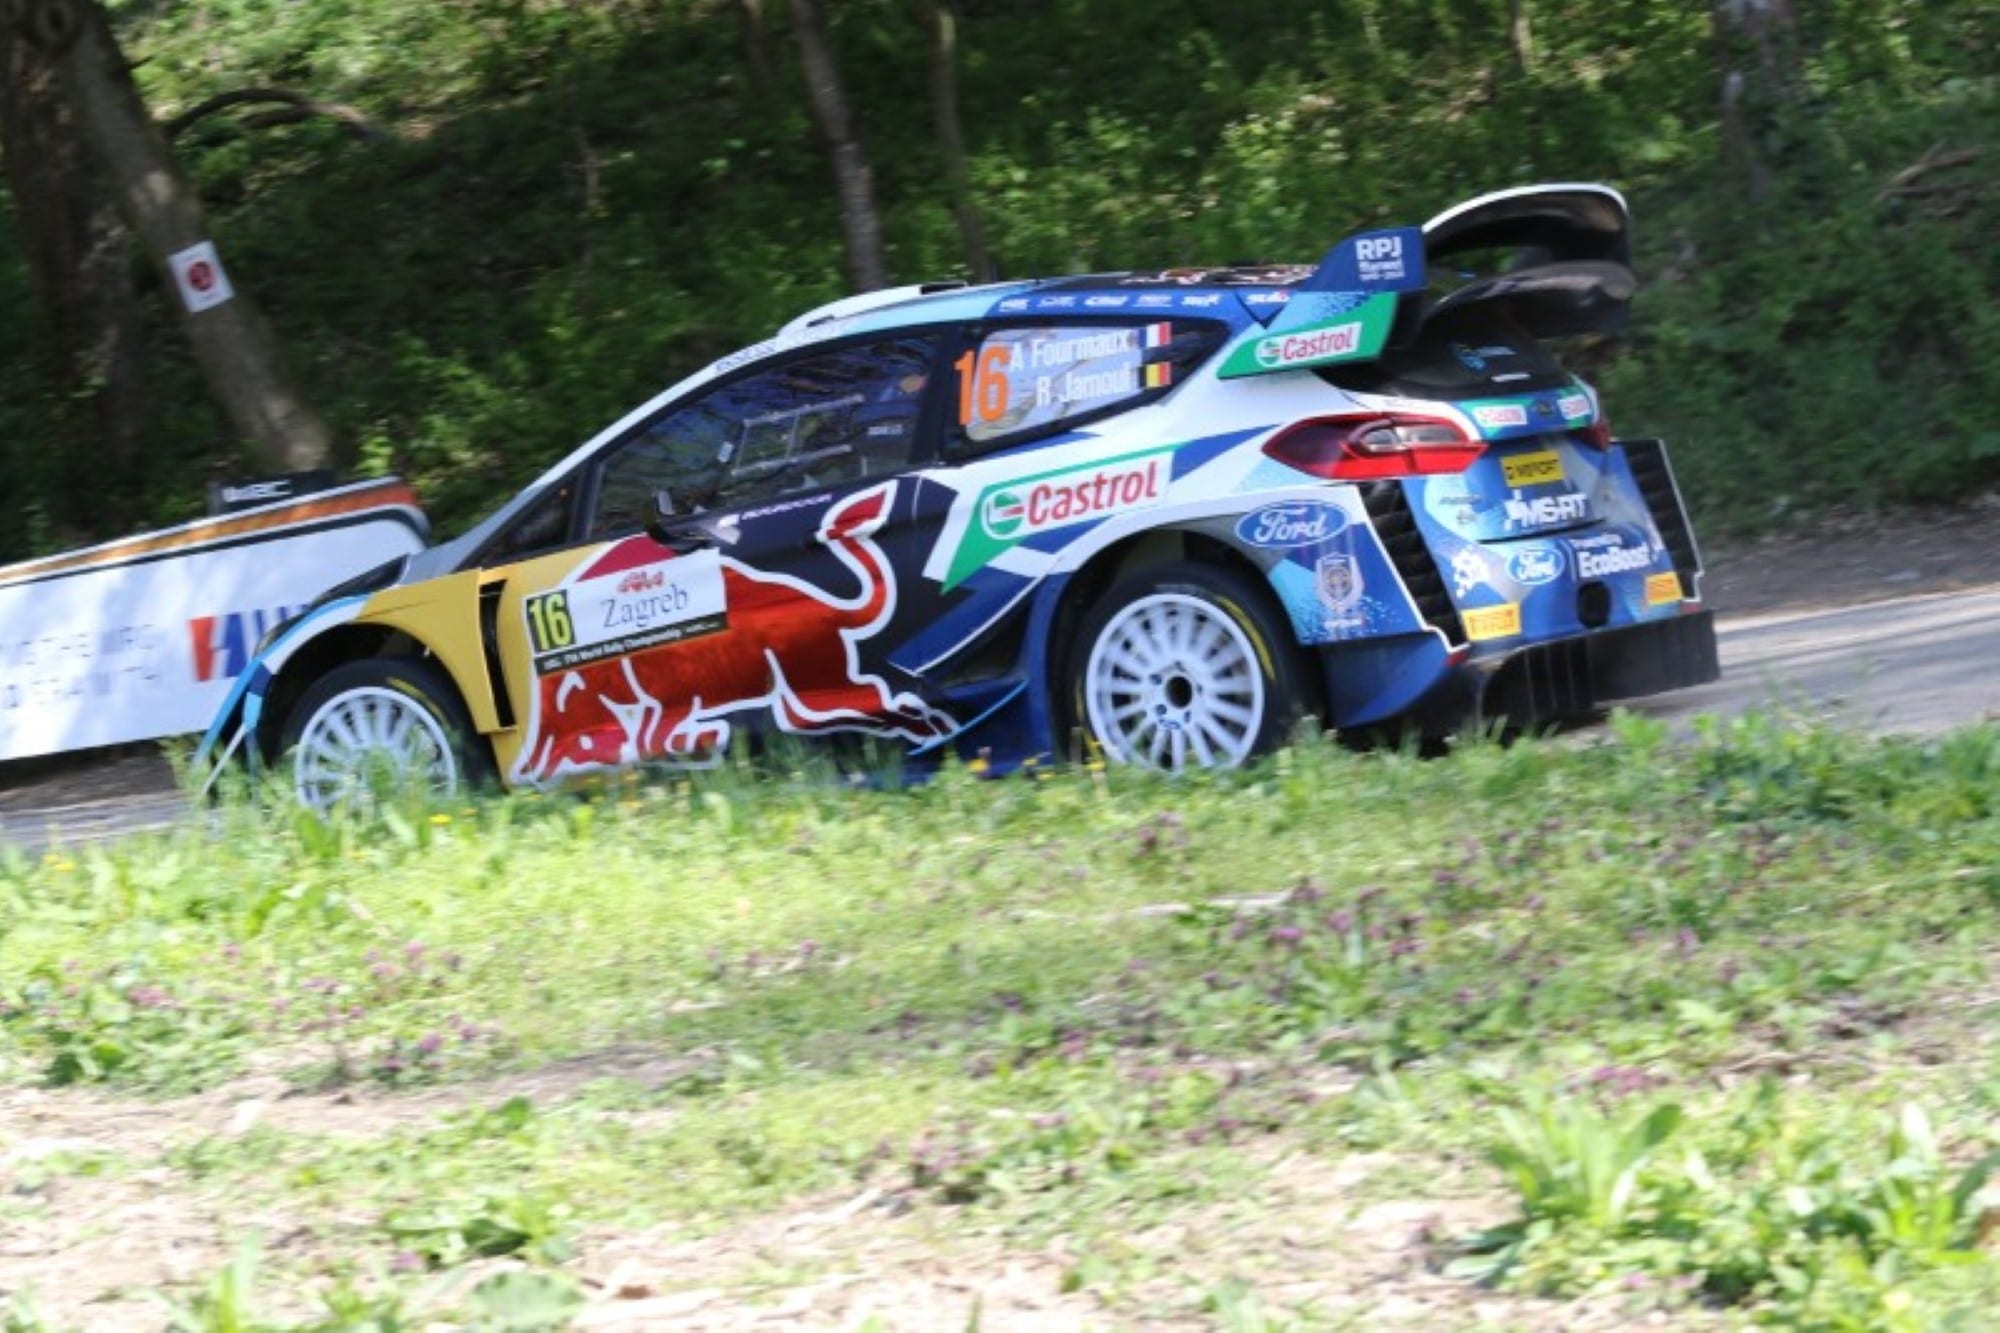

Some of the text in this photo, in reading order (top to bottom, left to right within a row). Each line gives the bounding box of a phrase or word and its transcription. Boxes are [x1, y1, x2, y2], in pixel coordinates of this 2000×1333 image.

[1356, 236, 1402, 260] RPJ
[1009, 329, 1133, 371] A Fourmaux
[1283, 328, 1354, 361] Castrol
[954, 345, 1012, 426] 16
[1027, 460, 1158, 527] Castrol
[1253, 507, 1328, 543] Ford
[1577, 541, 1650, 578] EcoBoost
[528, 593, 573, 651] 16
[602, 583, 690, 629] Zagreb
